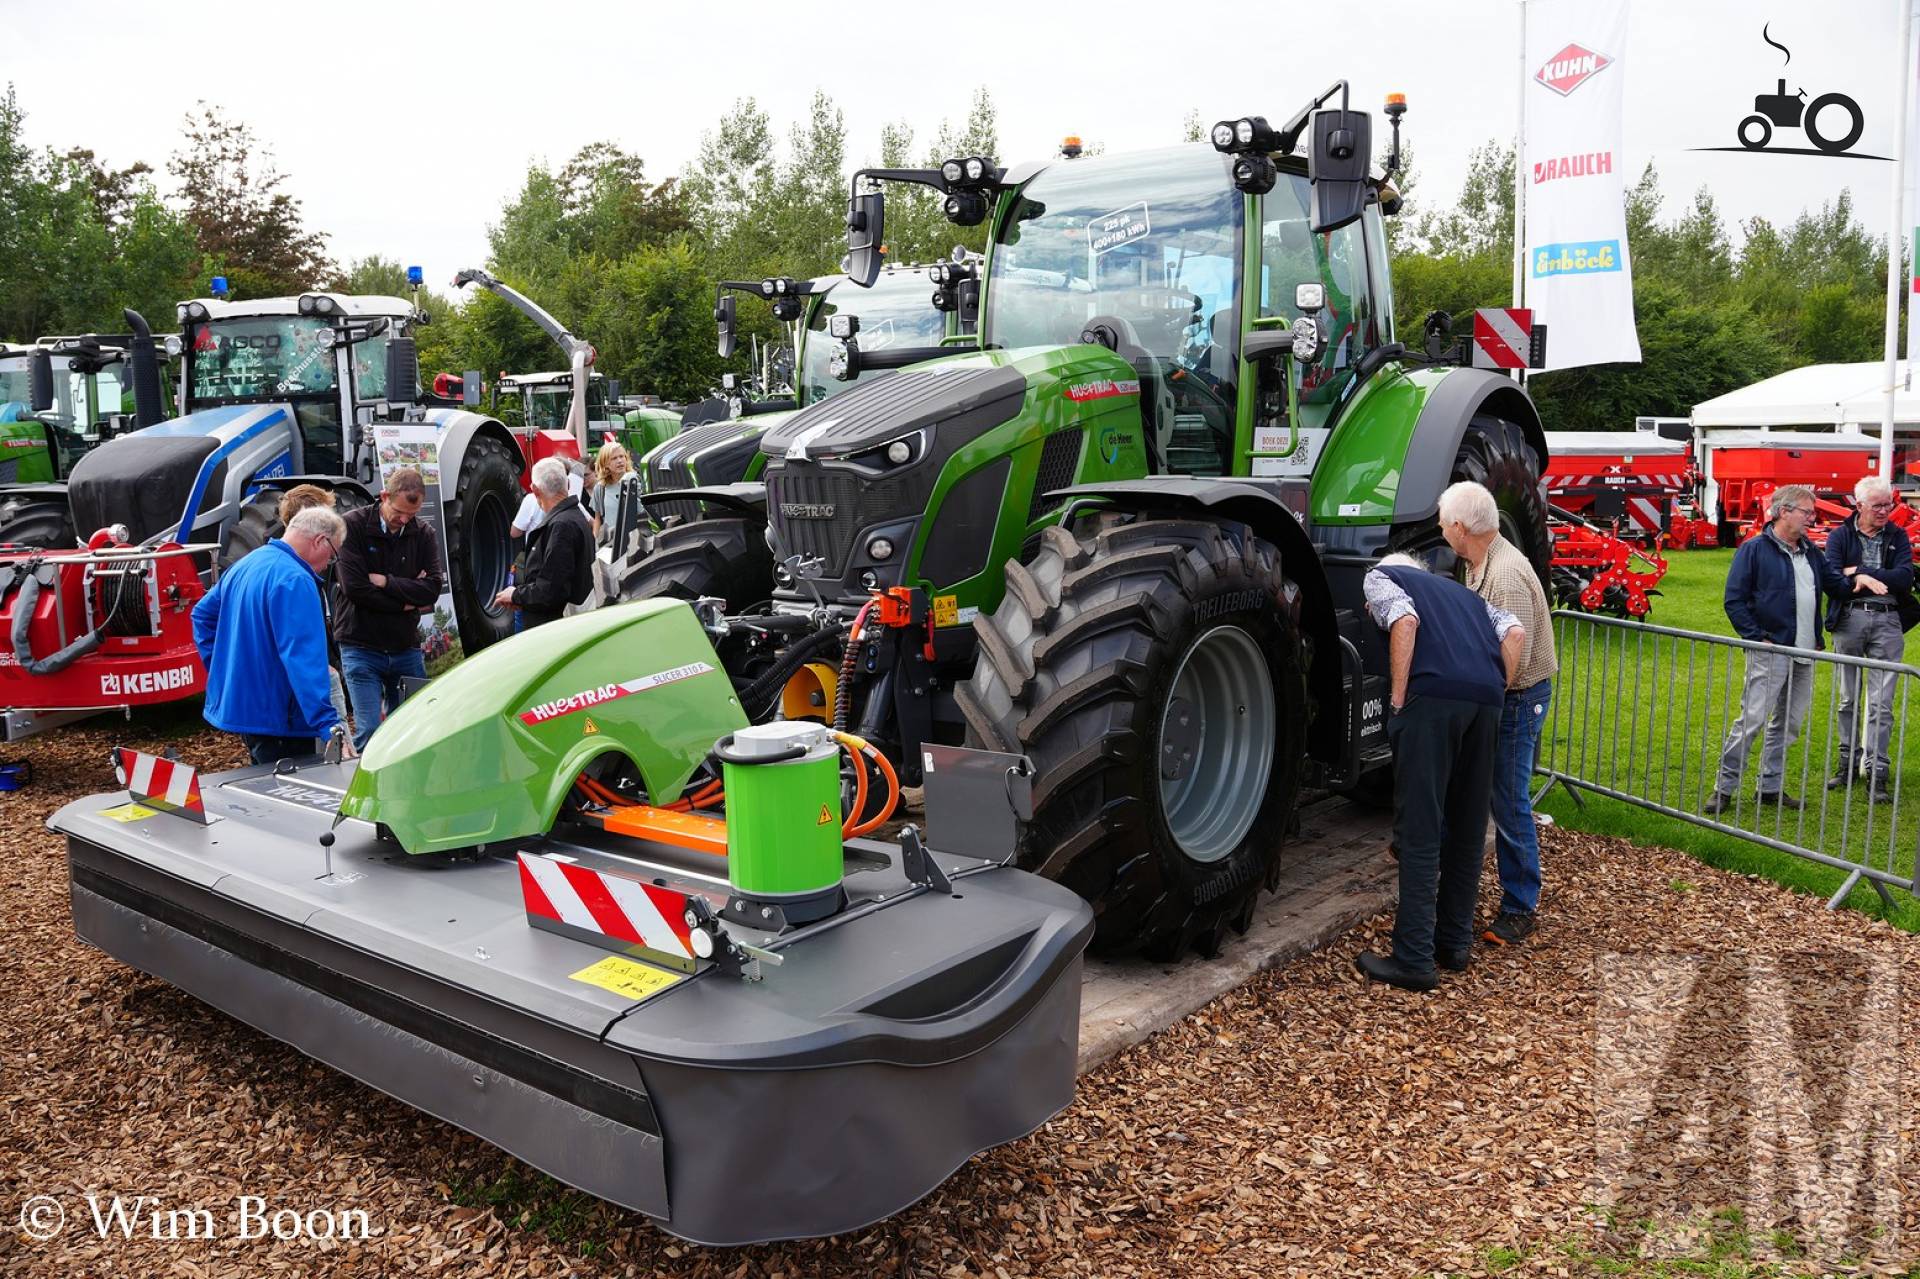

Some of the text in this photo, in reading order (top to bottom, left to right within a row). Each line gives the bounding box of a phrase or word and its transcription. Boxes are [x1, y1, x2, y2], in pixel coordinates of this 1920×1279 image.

[1542, 54, 1598, 82] KUHN
[1546, 151, 1612, 181] RAUCH
[1192, 588, 1265, 625] TRELLEBORG
[123, 664, 194, 695] KENBRI
[652, 669, 683, 685] SLICER
[683, 664, 698, 676] 310
